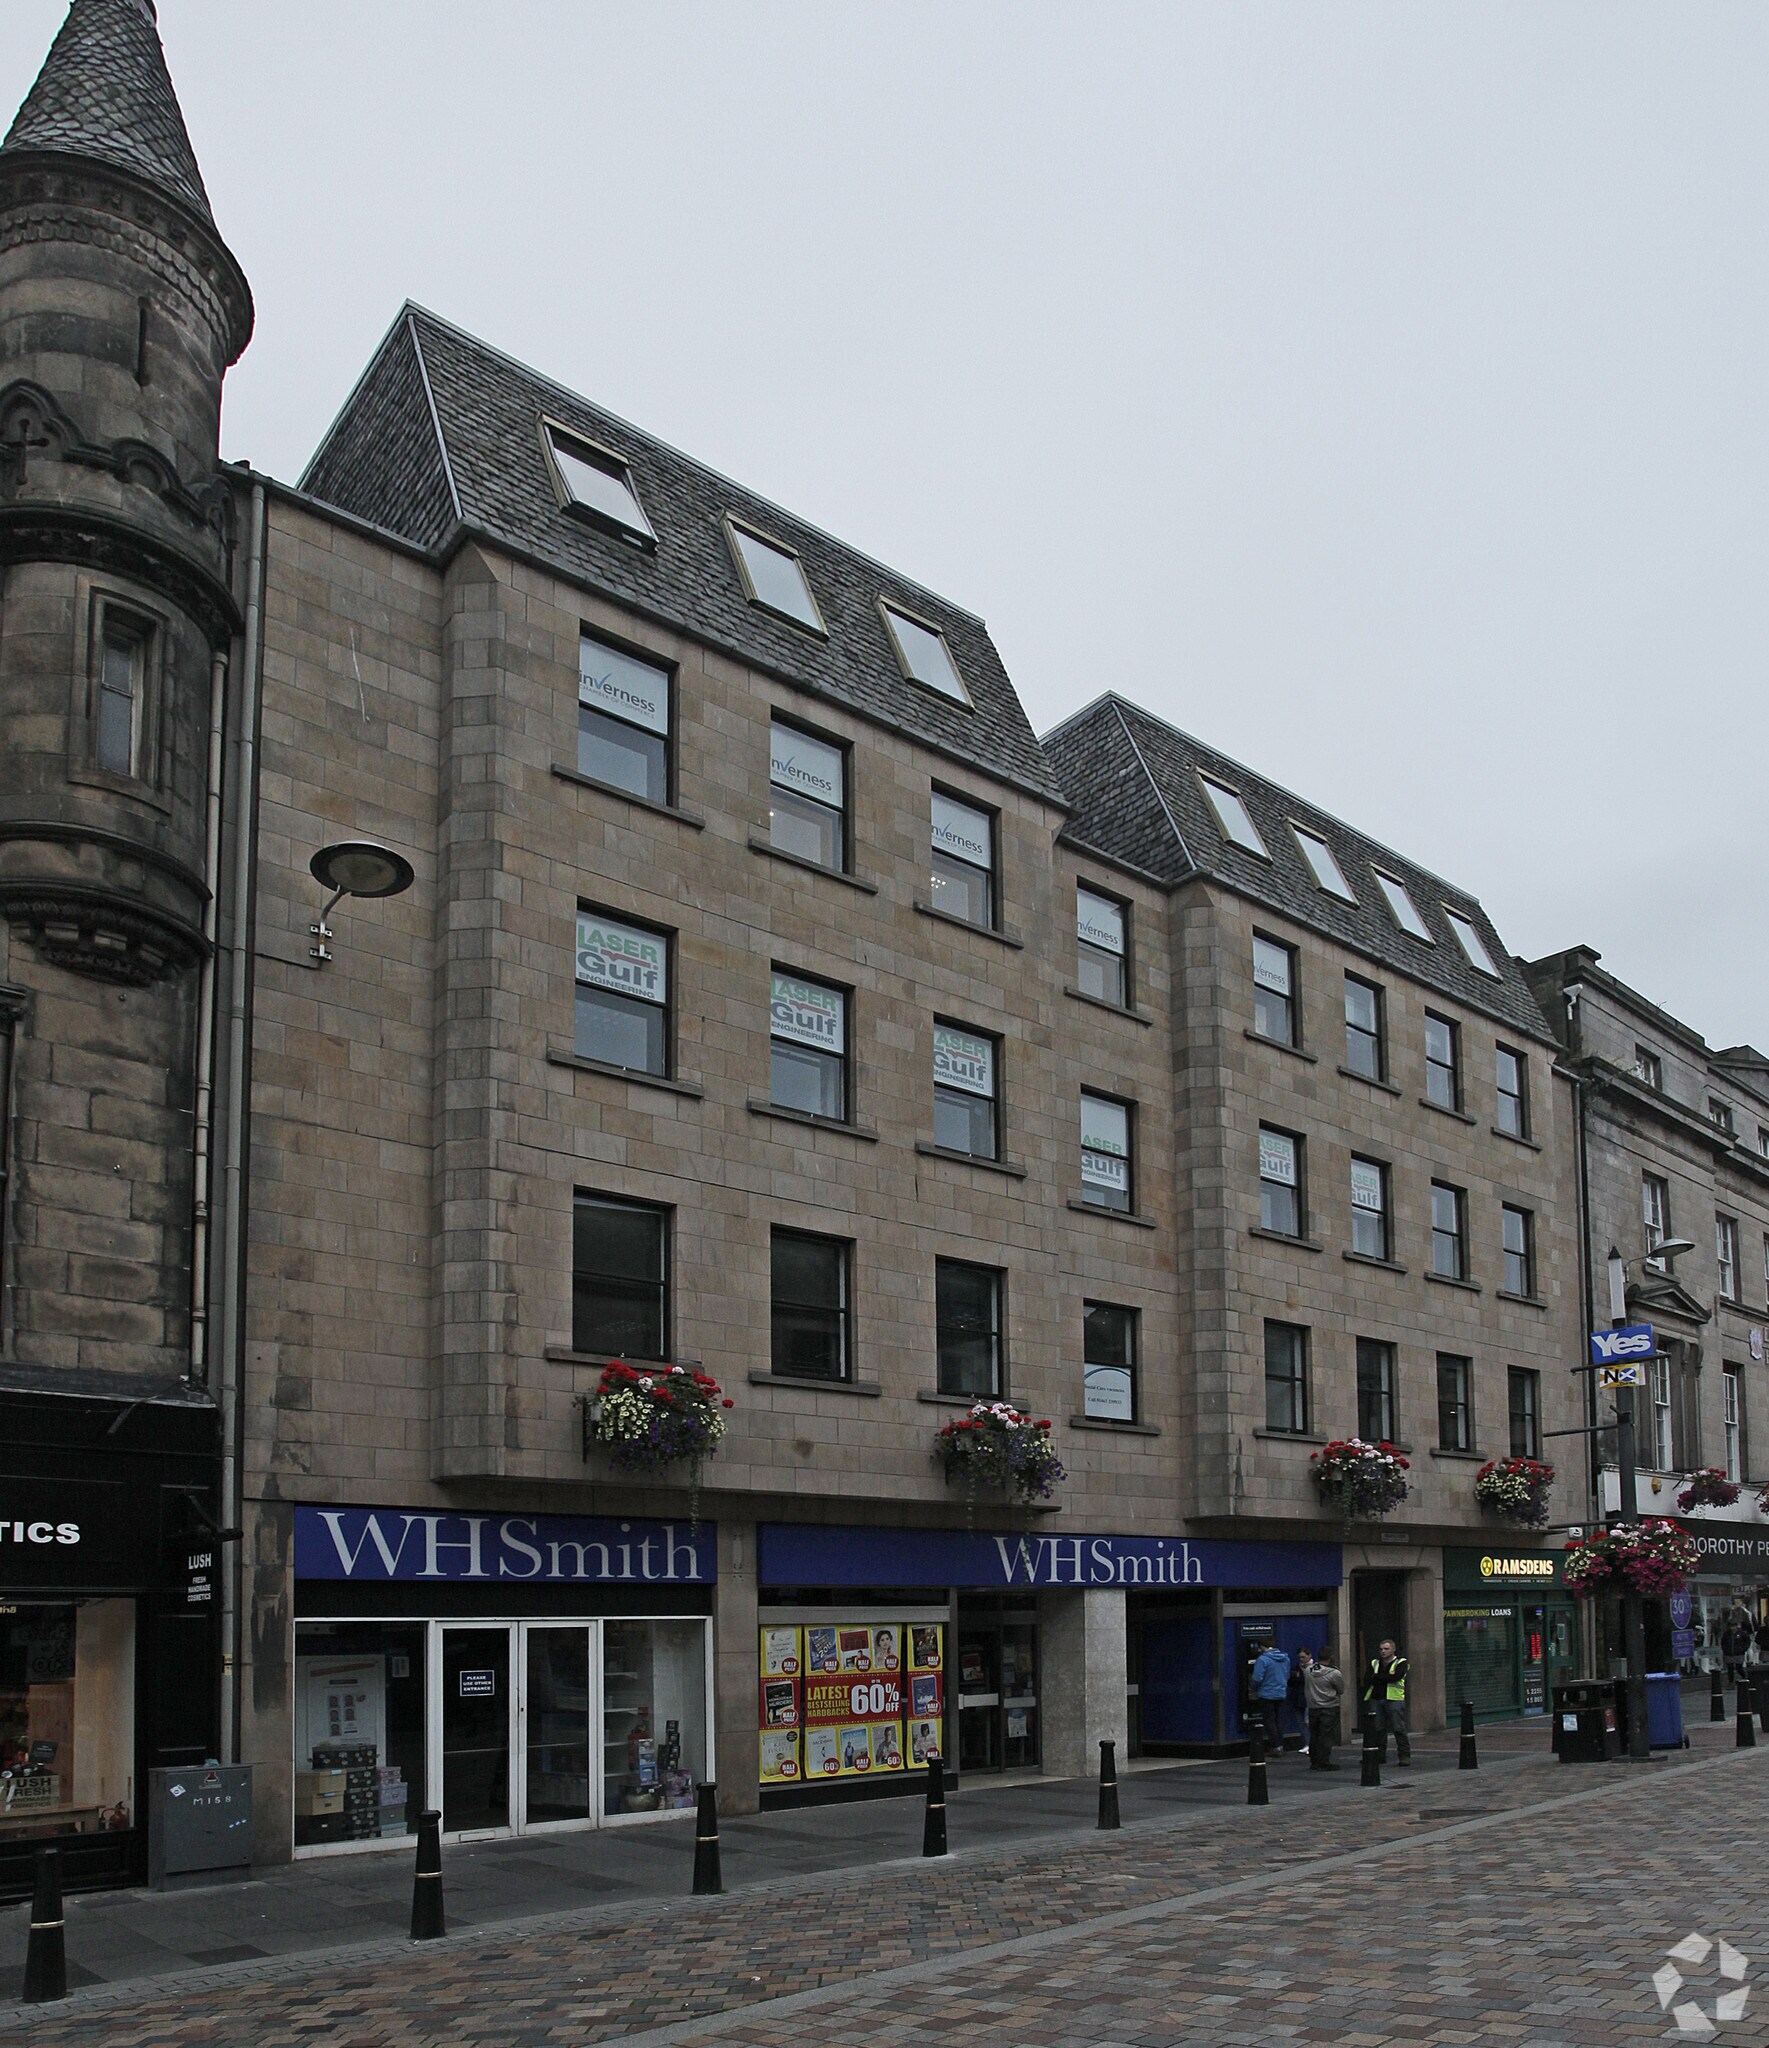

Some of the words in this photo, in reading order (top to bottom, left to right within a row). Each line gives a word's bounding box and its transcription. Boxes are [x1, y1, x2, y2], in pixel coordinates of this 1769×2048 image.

[577, 924, 659, 963] LASER
[577, 951, 659, 989] Gulf
[578, 972, 656, 998] ENGINEERING
[771, 1002, 837, 1035] Gulf
[934, 1050, 987, 1081] Gulf
[1591, 1333, 1651, 1357] Yes
[317, 1512, 704, 1580] WHSmith
[188, 1553, 212, 1570] LUSH
[992, 1536, 1205, 1584] WHSmith
[1493, 1558, 1554, 1575] RAMSDENS
[1443, 1608, 1490, 1617] PAWNBROKING
[1491, 1608, 1512, 1616] LOANS
[807, 1686, 850, 1701] LATEST
[807, 1700, 850, 1710] BESTSELLING
[885, 1702, 900, 1713] OFF
[807, 1708, 850, 1718] HARDBACKS
